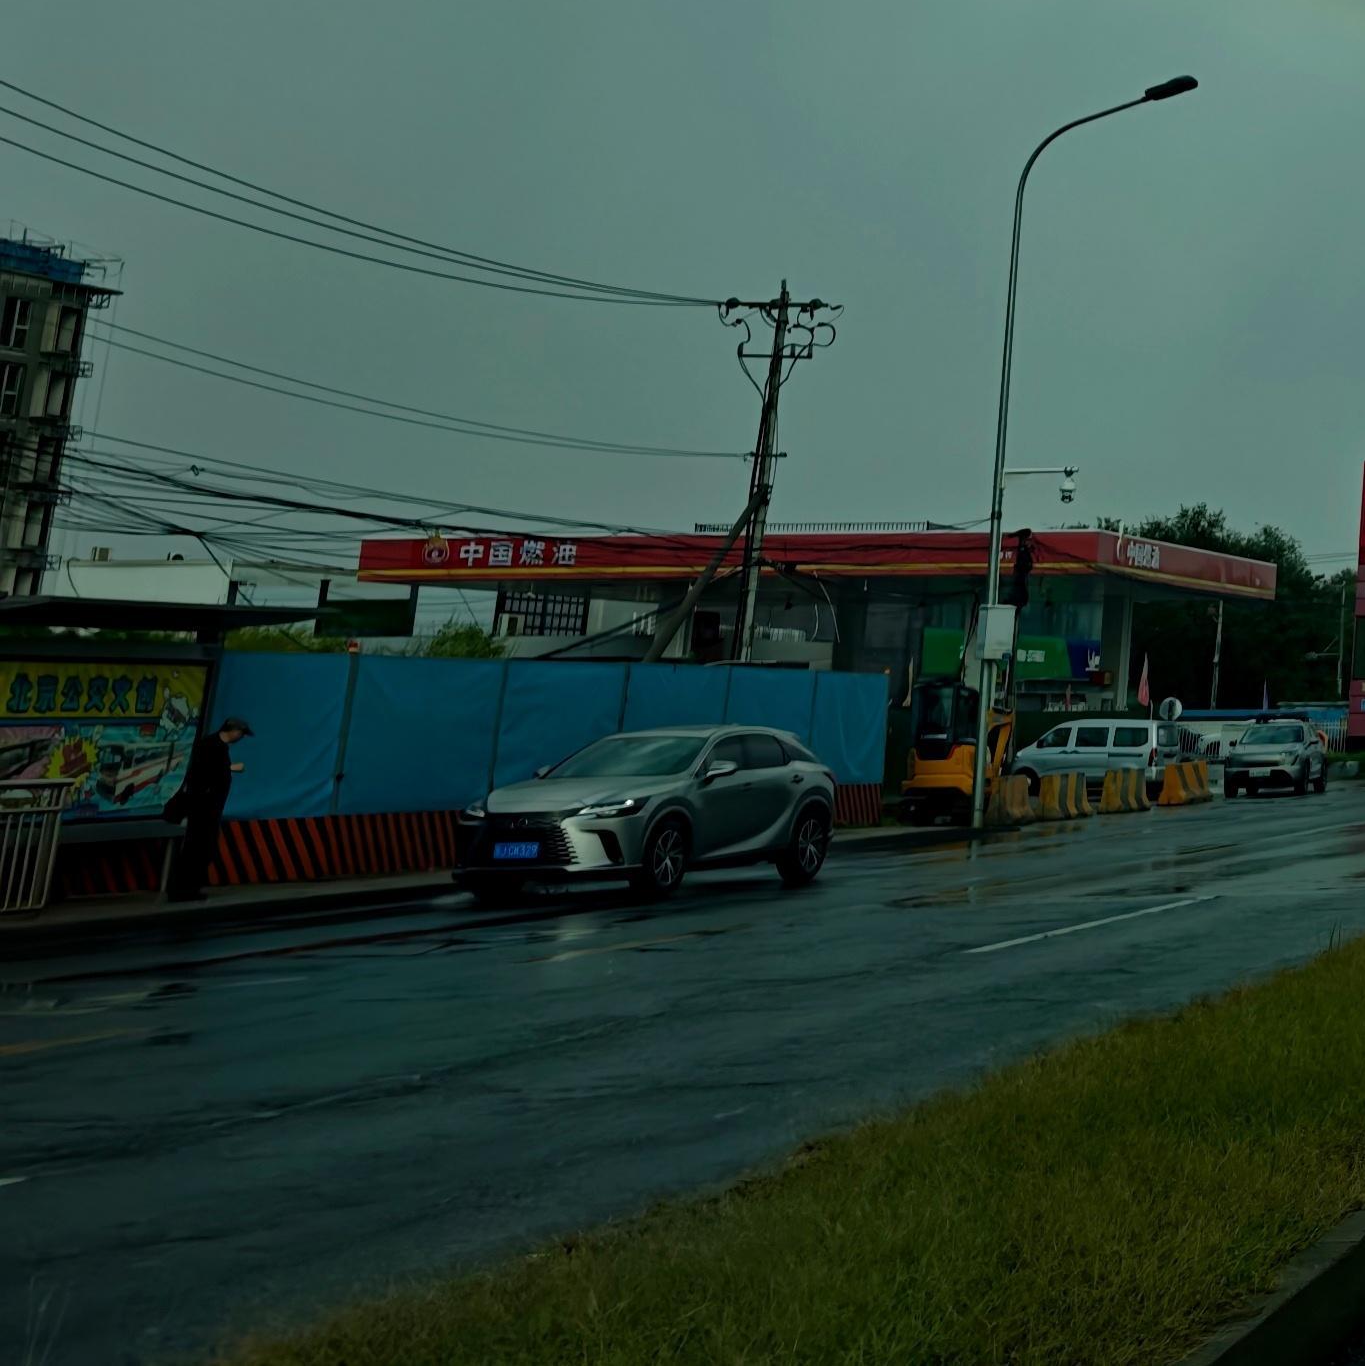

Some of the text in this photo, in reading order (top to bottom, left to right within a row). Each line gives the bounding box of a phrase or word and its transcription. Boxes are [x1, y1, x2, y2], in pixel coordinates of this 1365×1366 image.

[459, 540, 577, 567] 中国燃油
[6, 673, 158, 714] 北京公交文创
